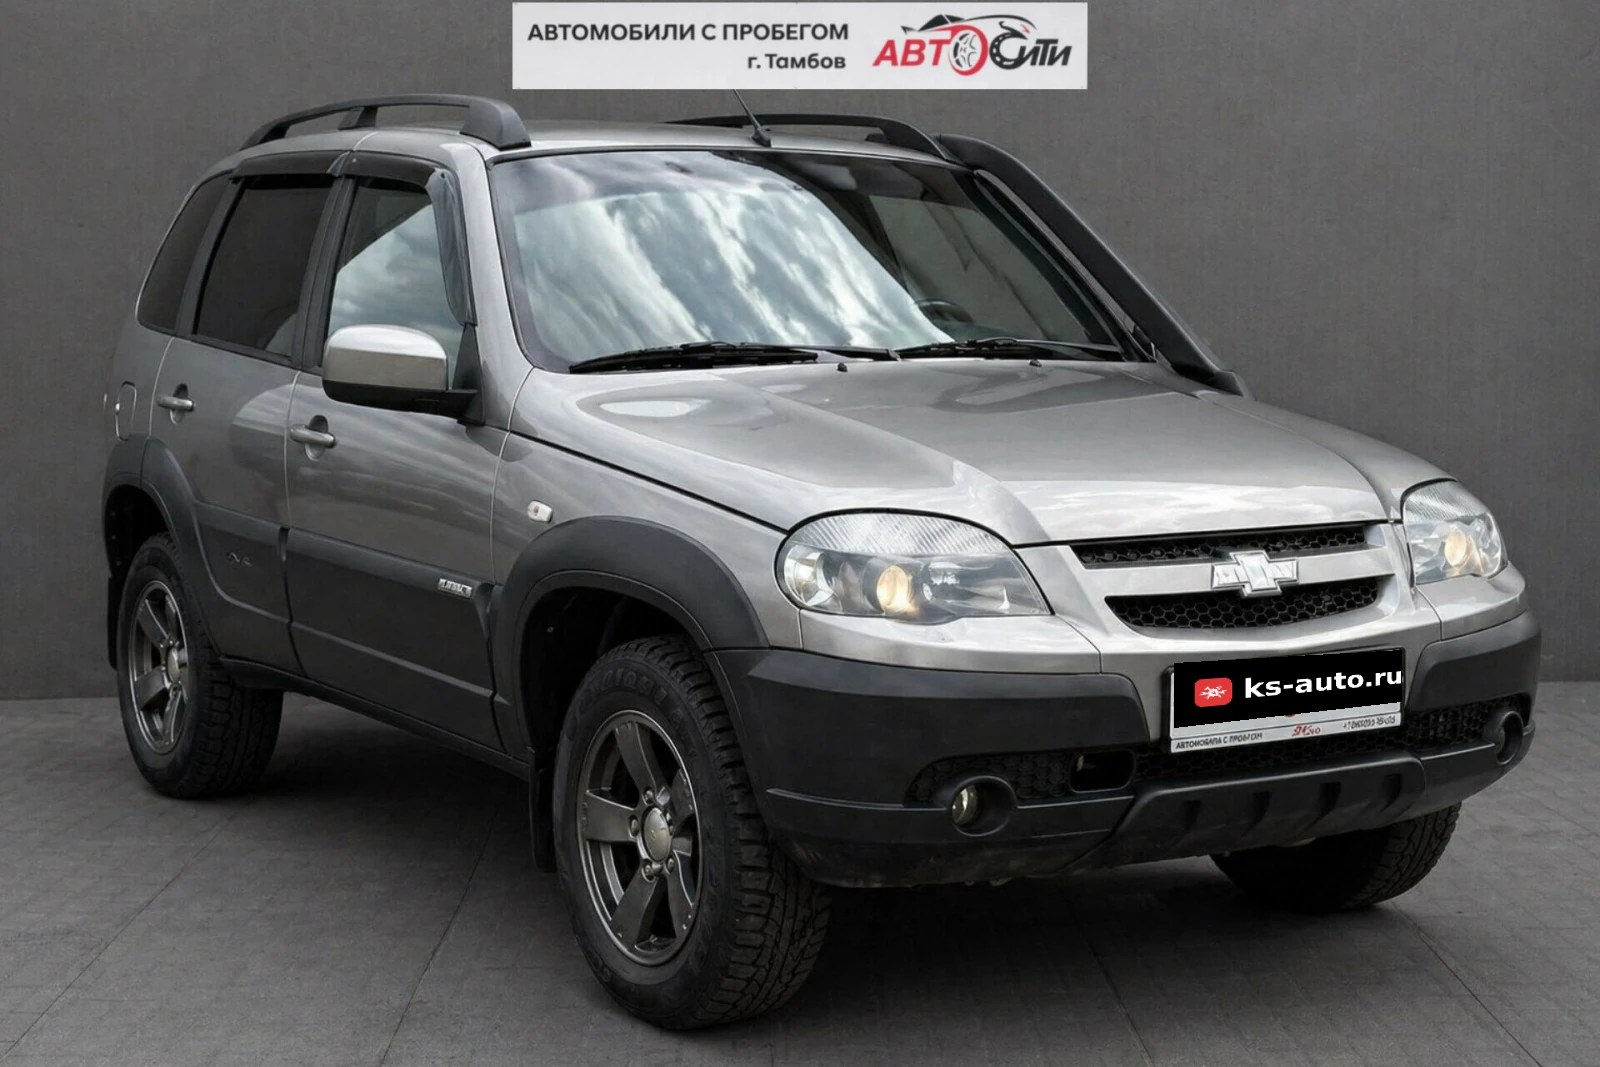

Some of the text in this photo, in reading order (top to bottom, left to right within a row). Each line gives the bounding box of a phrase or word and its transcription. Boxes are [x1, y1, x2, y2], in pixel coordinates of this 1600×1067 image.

[527, 24, 849, 41] АВТОМОБИЛИ С ПРОБЕГОМ
[747, 52, 846, 69] г. Тамбов
